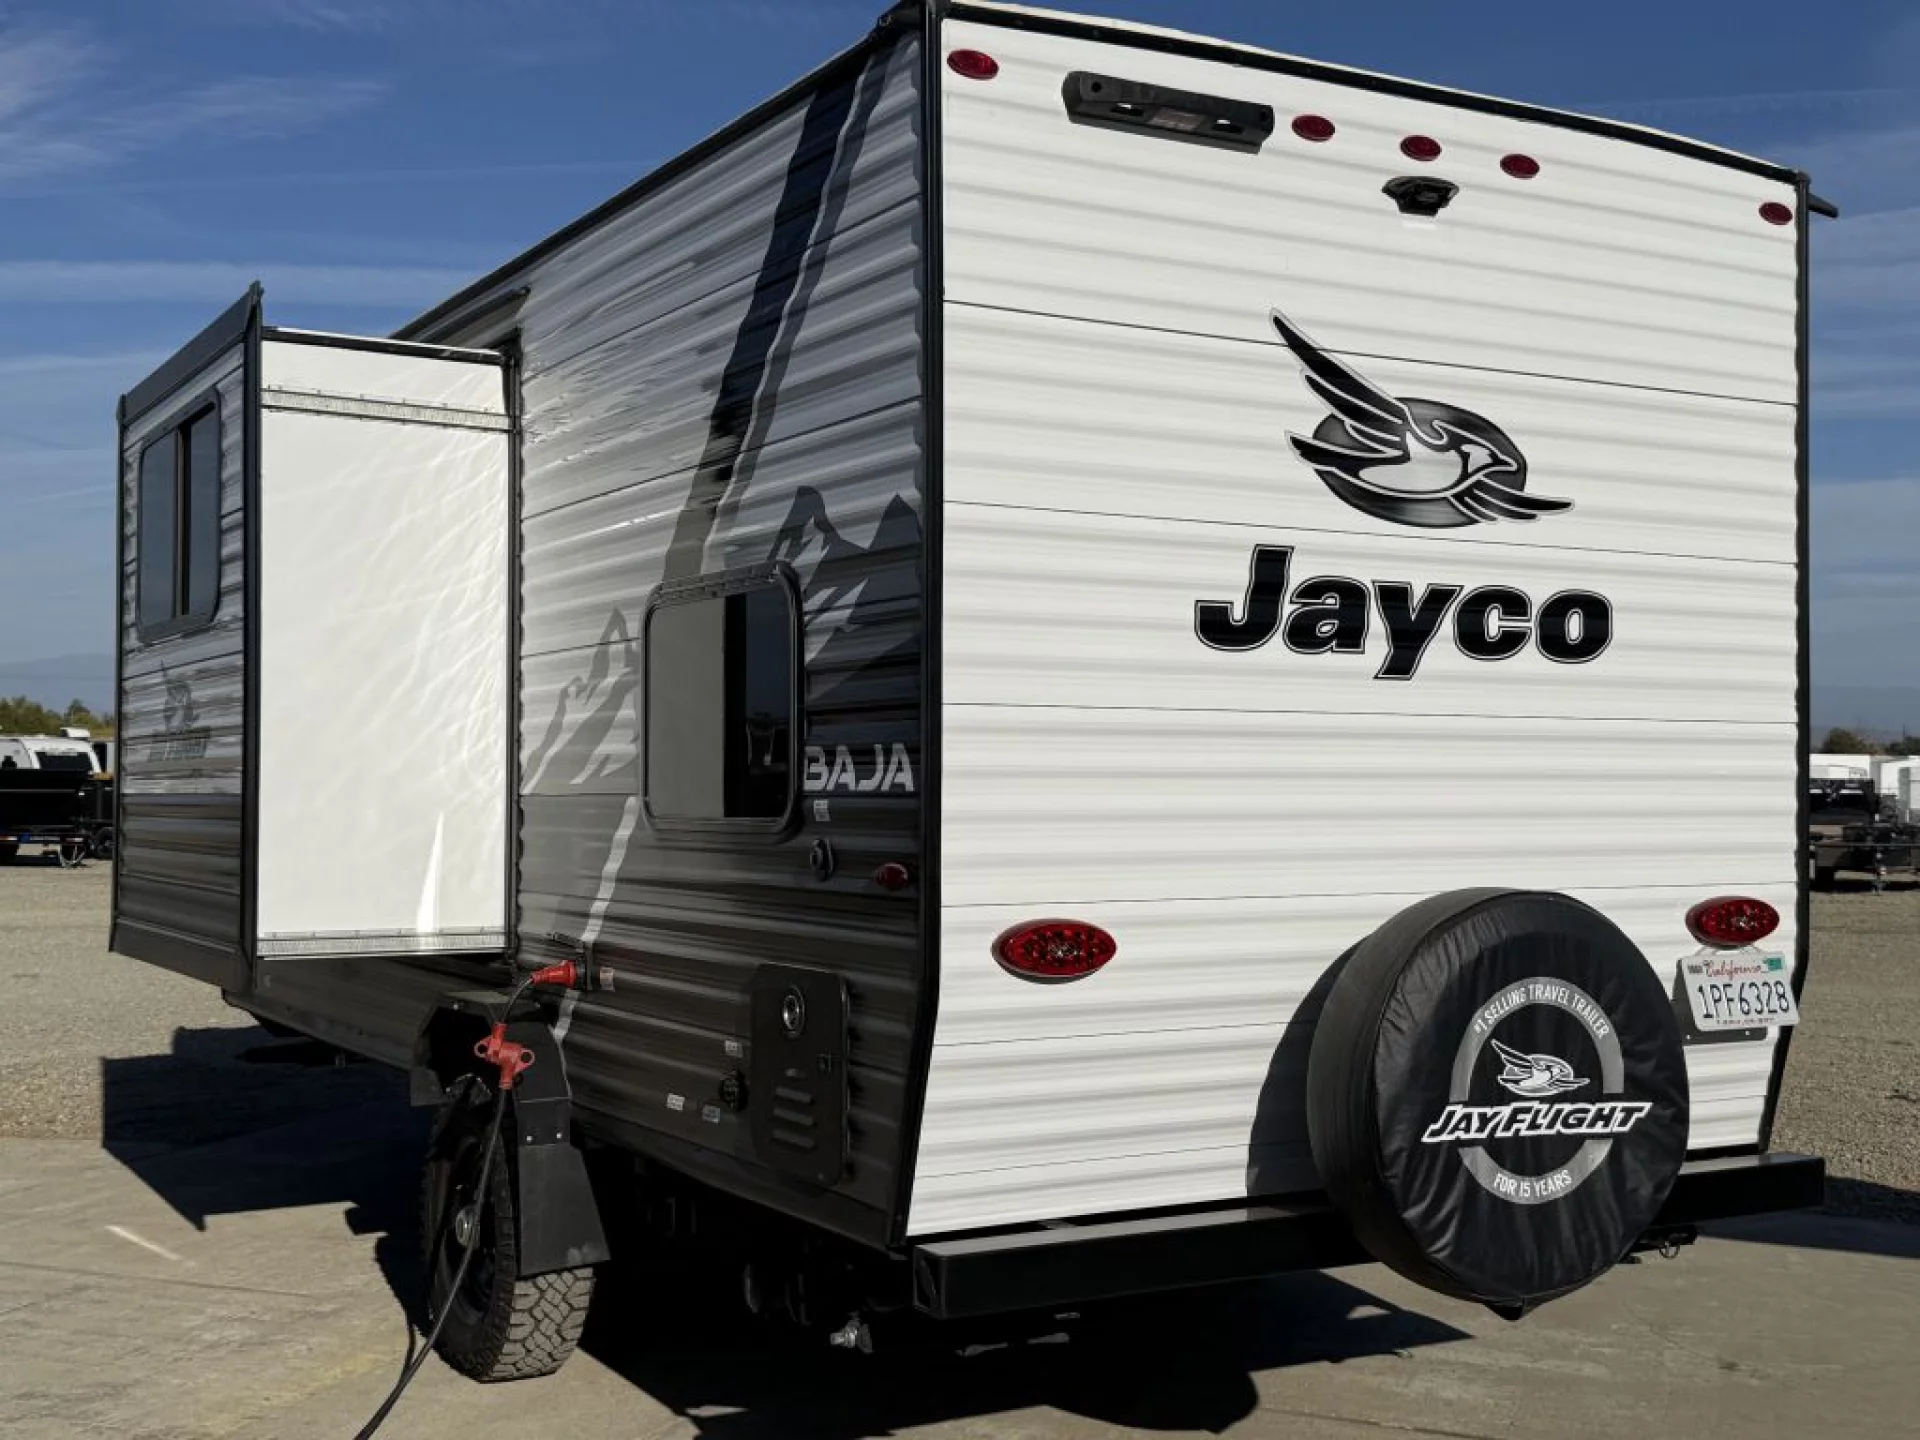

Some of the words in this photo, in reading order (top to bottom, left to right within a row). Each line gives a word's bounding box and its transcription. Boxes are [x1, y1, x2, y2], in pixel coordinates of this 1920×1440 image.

[1194, 543, 1614, 681] Jayco
[803, 743, 915, 791] BAJA
[1704, 959, 1762, 981] California
[1484, 987, 1527, 1023] SELLING
[1528, 983, 1571, 1006] TRAVEL
[1572, 993, 1610, 1038] TRAILER
[1697, 980, 1790, 1019] 1PF6328
[1493, 1172, 1517, 1194] FOR
[1519, 1180, 1532, 1198] 15
[1533, 1169, 1572, 1198] YEARS
